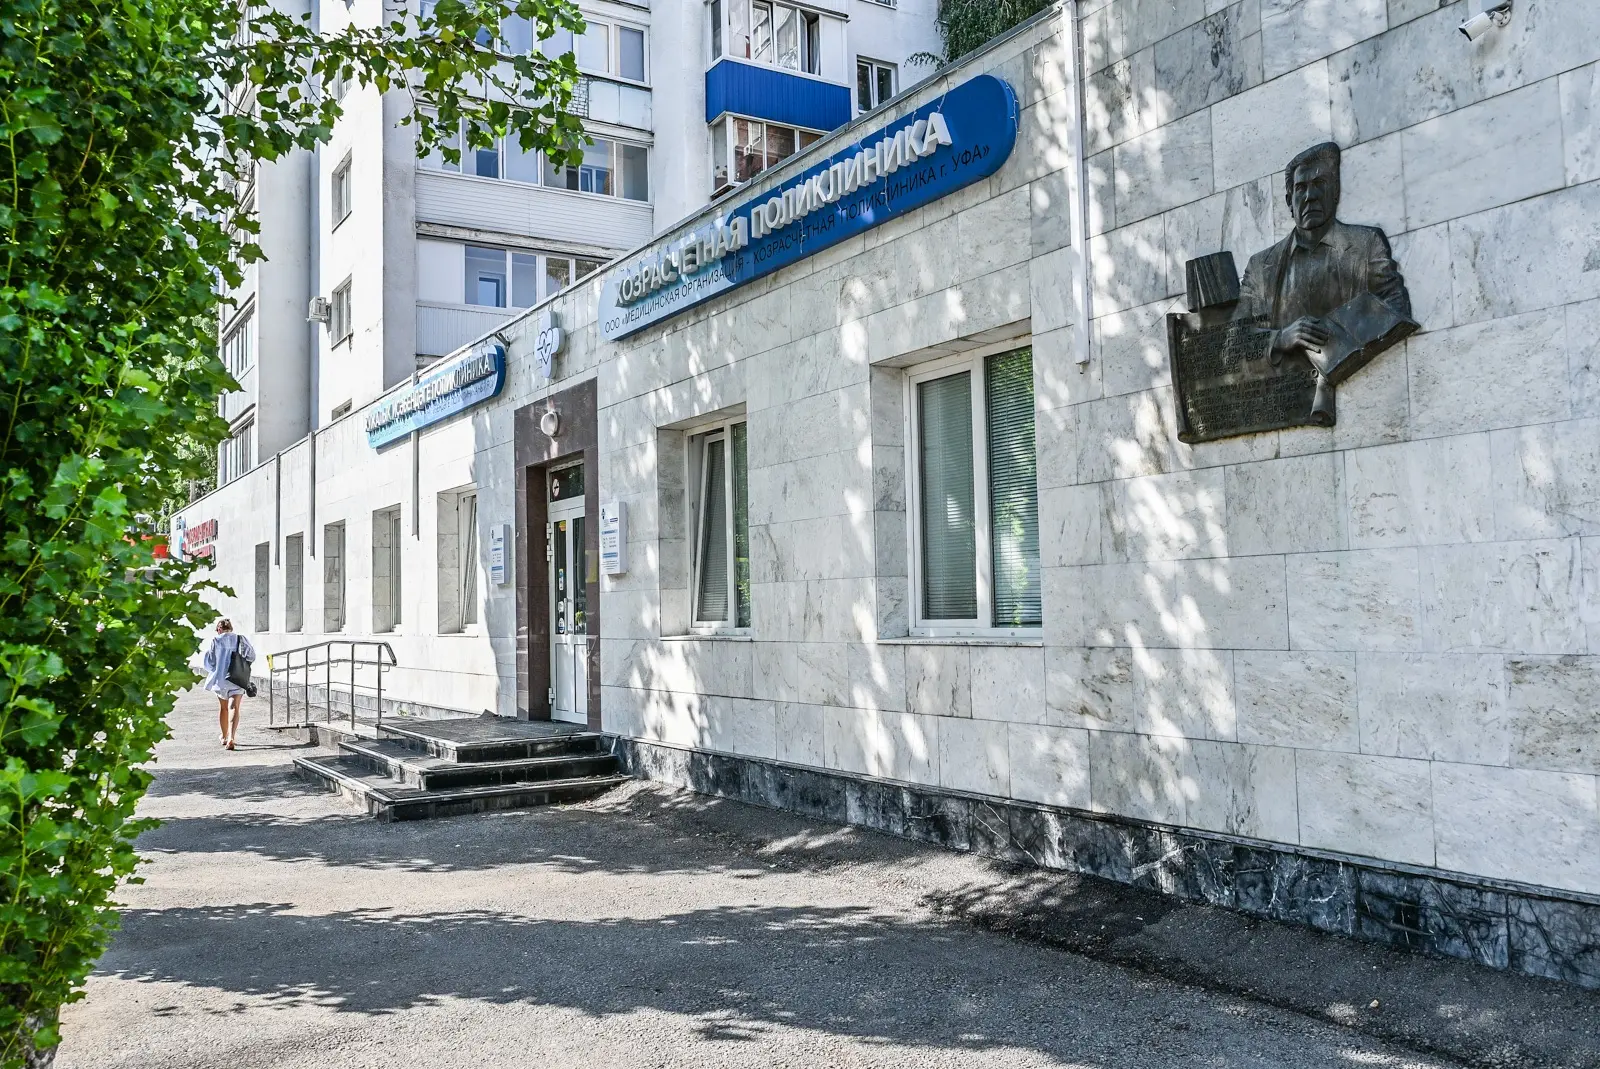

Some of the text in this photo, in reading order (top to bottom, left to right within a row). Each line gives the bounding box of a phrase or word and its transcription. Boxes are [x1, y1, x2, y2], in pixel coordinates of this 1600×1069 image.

[604, 317, 620, 334] ООО
[621, 289, 680, 325] «МЕДИЦИНСКАЯ
[681, 256, 744, 298] ОРГАНИЗАЦИЯ
[840, 166, 936, 224] ПОЛИКЛИНИКА
[952, 144, 990, 172] УФА»
[614, 111, 953, 308] ХОЗРАСЧЕТНАЯ ПОЛИКЛИНИКА
